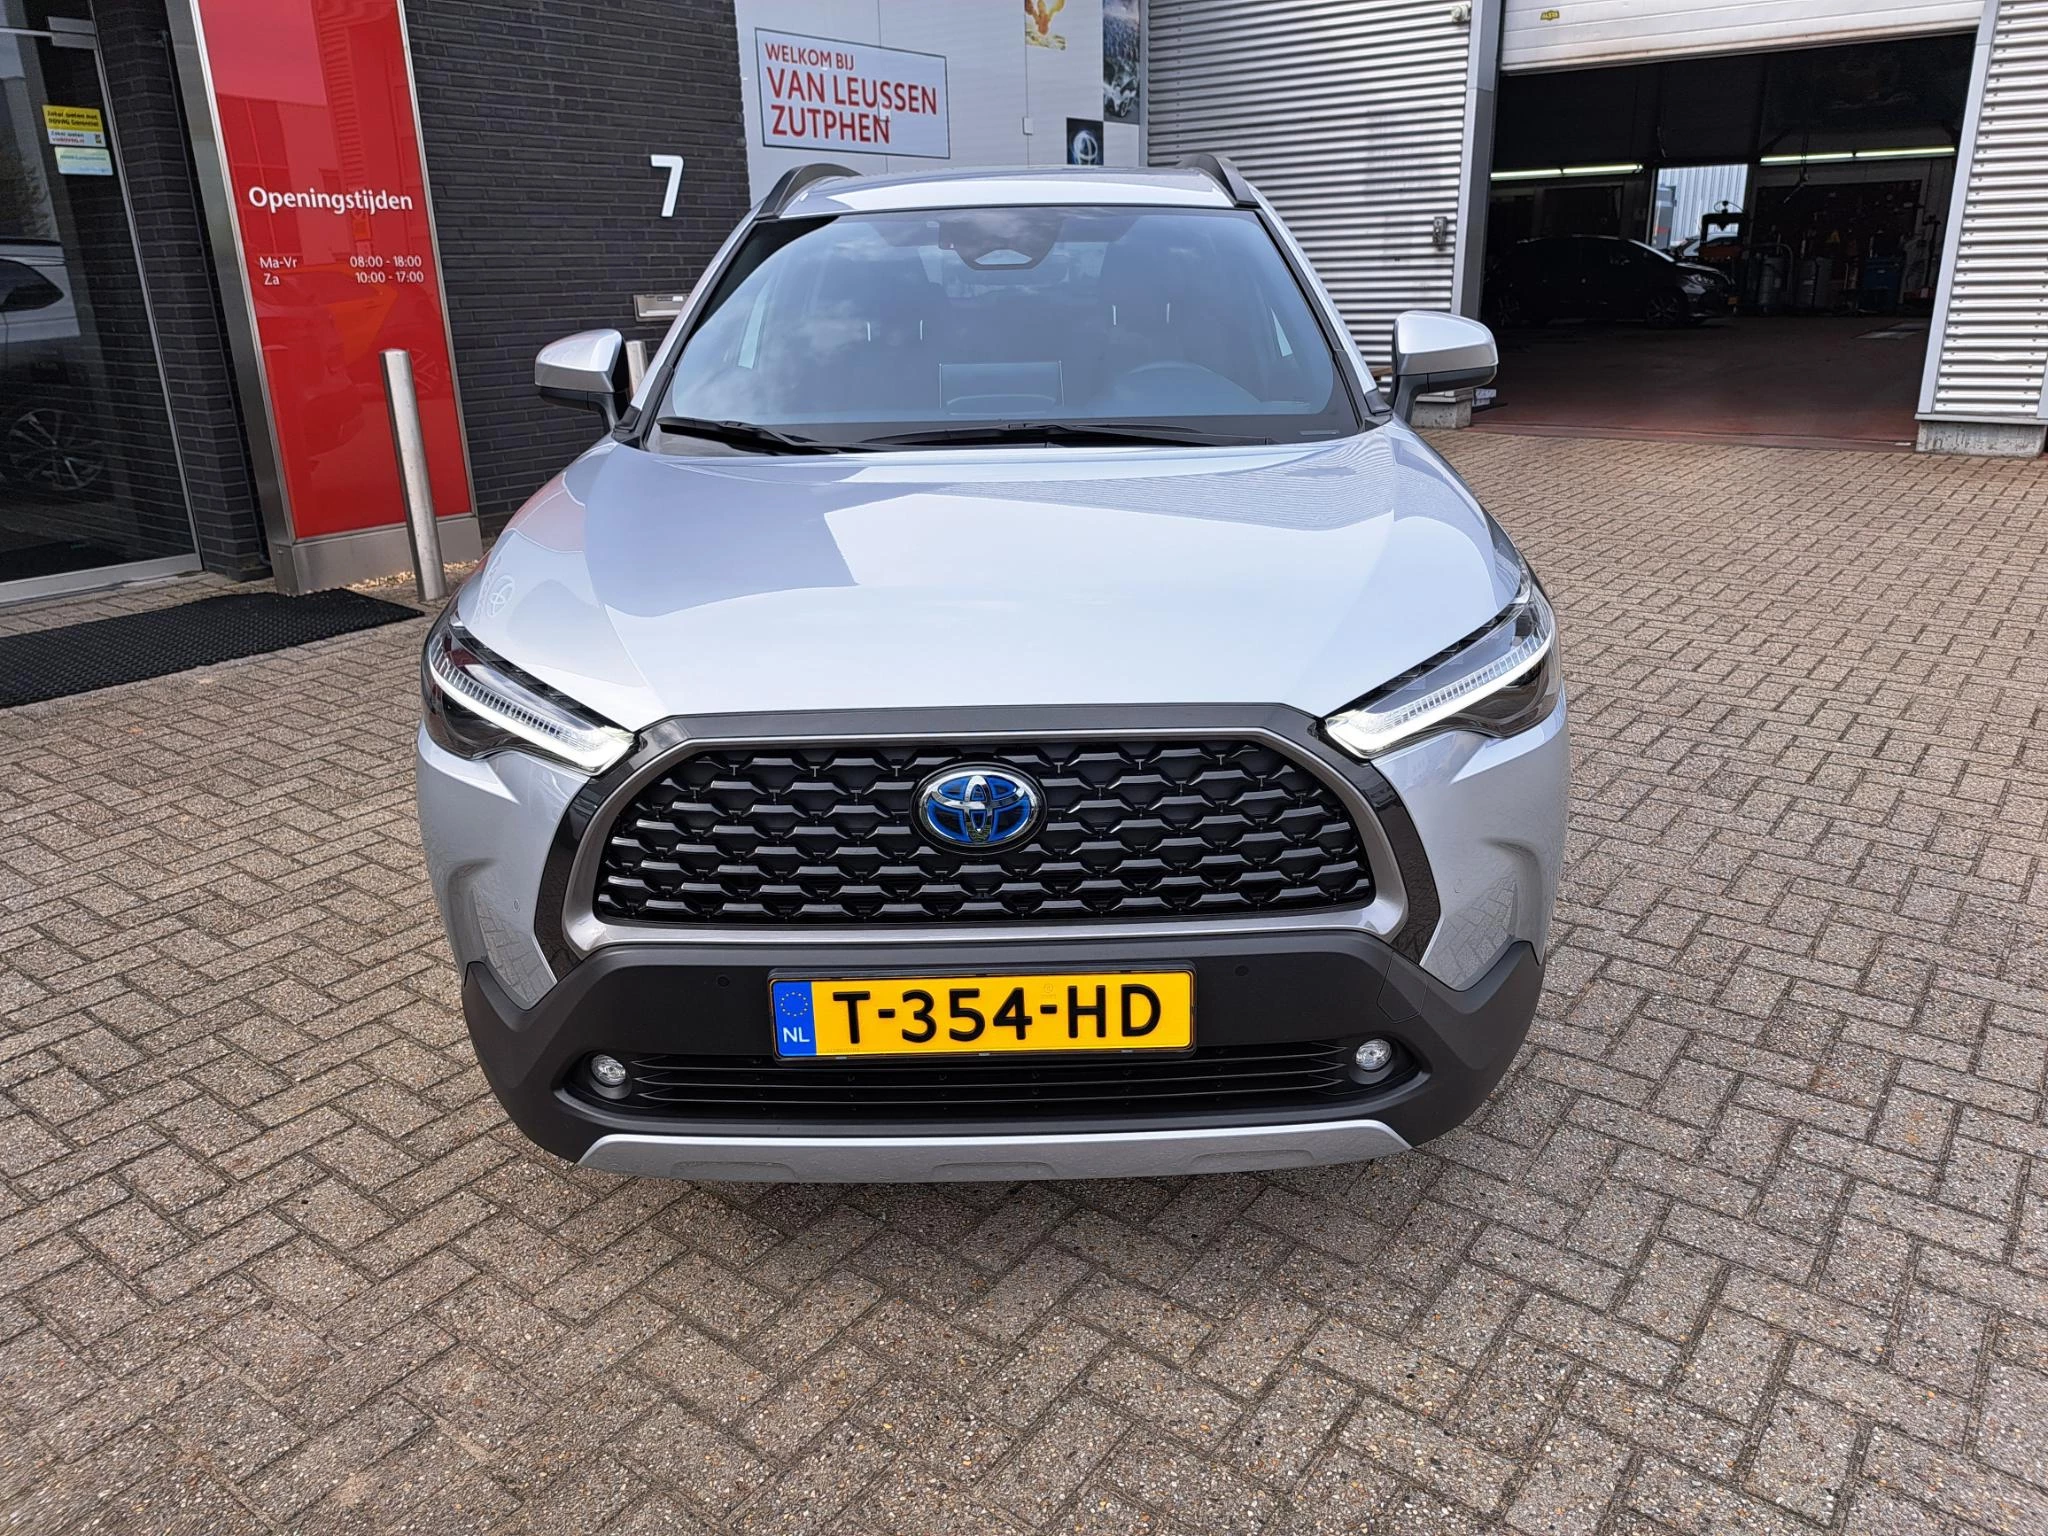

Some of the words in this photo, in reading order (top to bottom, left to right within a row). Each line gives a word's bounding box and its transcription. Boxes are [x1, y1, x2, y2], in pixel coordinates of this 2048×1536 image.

[765, 42, 832, 68] WELKOM
[836, 52, 855, 71] BIJ
[766, 66, 825, 103] VAN
[833, 74, 937, 115] LEUSSEN
[771, 104, 890, 144] ZUTPHEN
[650, 154, 684, 217] 7
[248, 186, 413, 215] Openingstijden
[259, 256, 298, 269] Ma-Vr
[350, 256, 383, 268] 08:00
[393, 256, 422, 267] 18:00
[264, 273, 280, 286] Za
[356, 272, 386, 283] 10:00
[396, 271, 424, 283] 17:00
[832, 983, 1162, 1045] T-354-HD
[783, 1026, 810, 1043] NL
